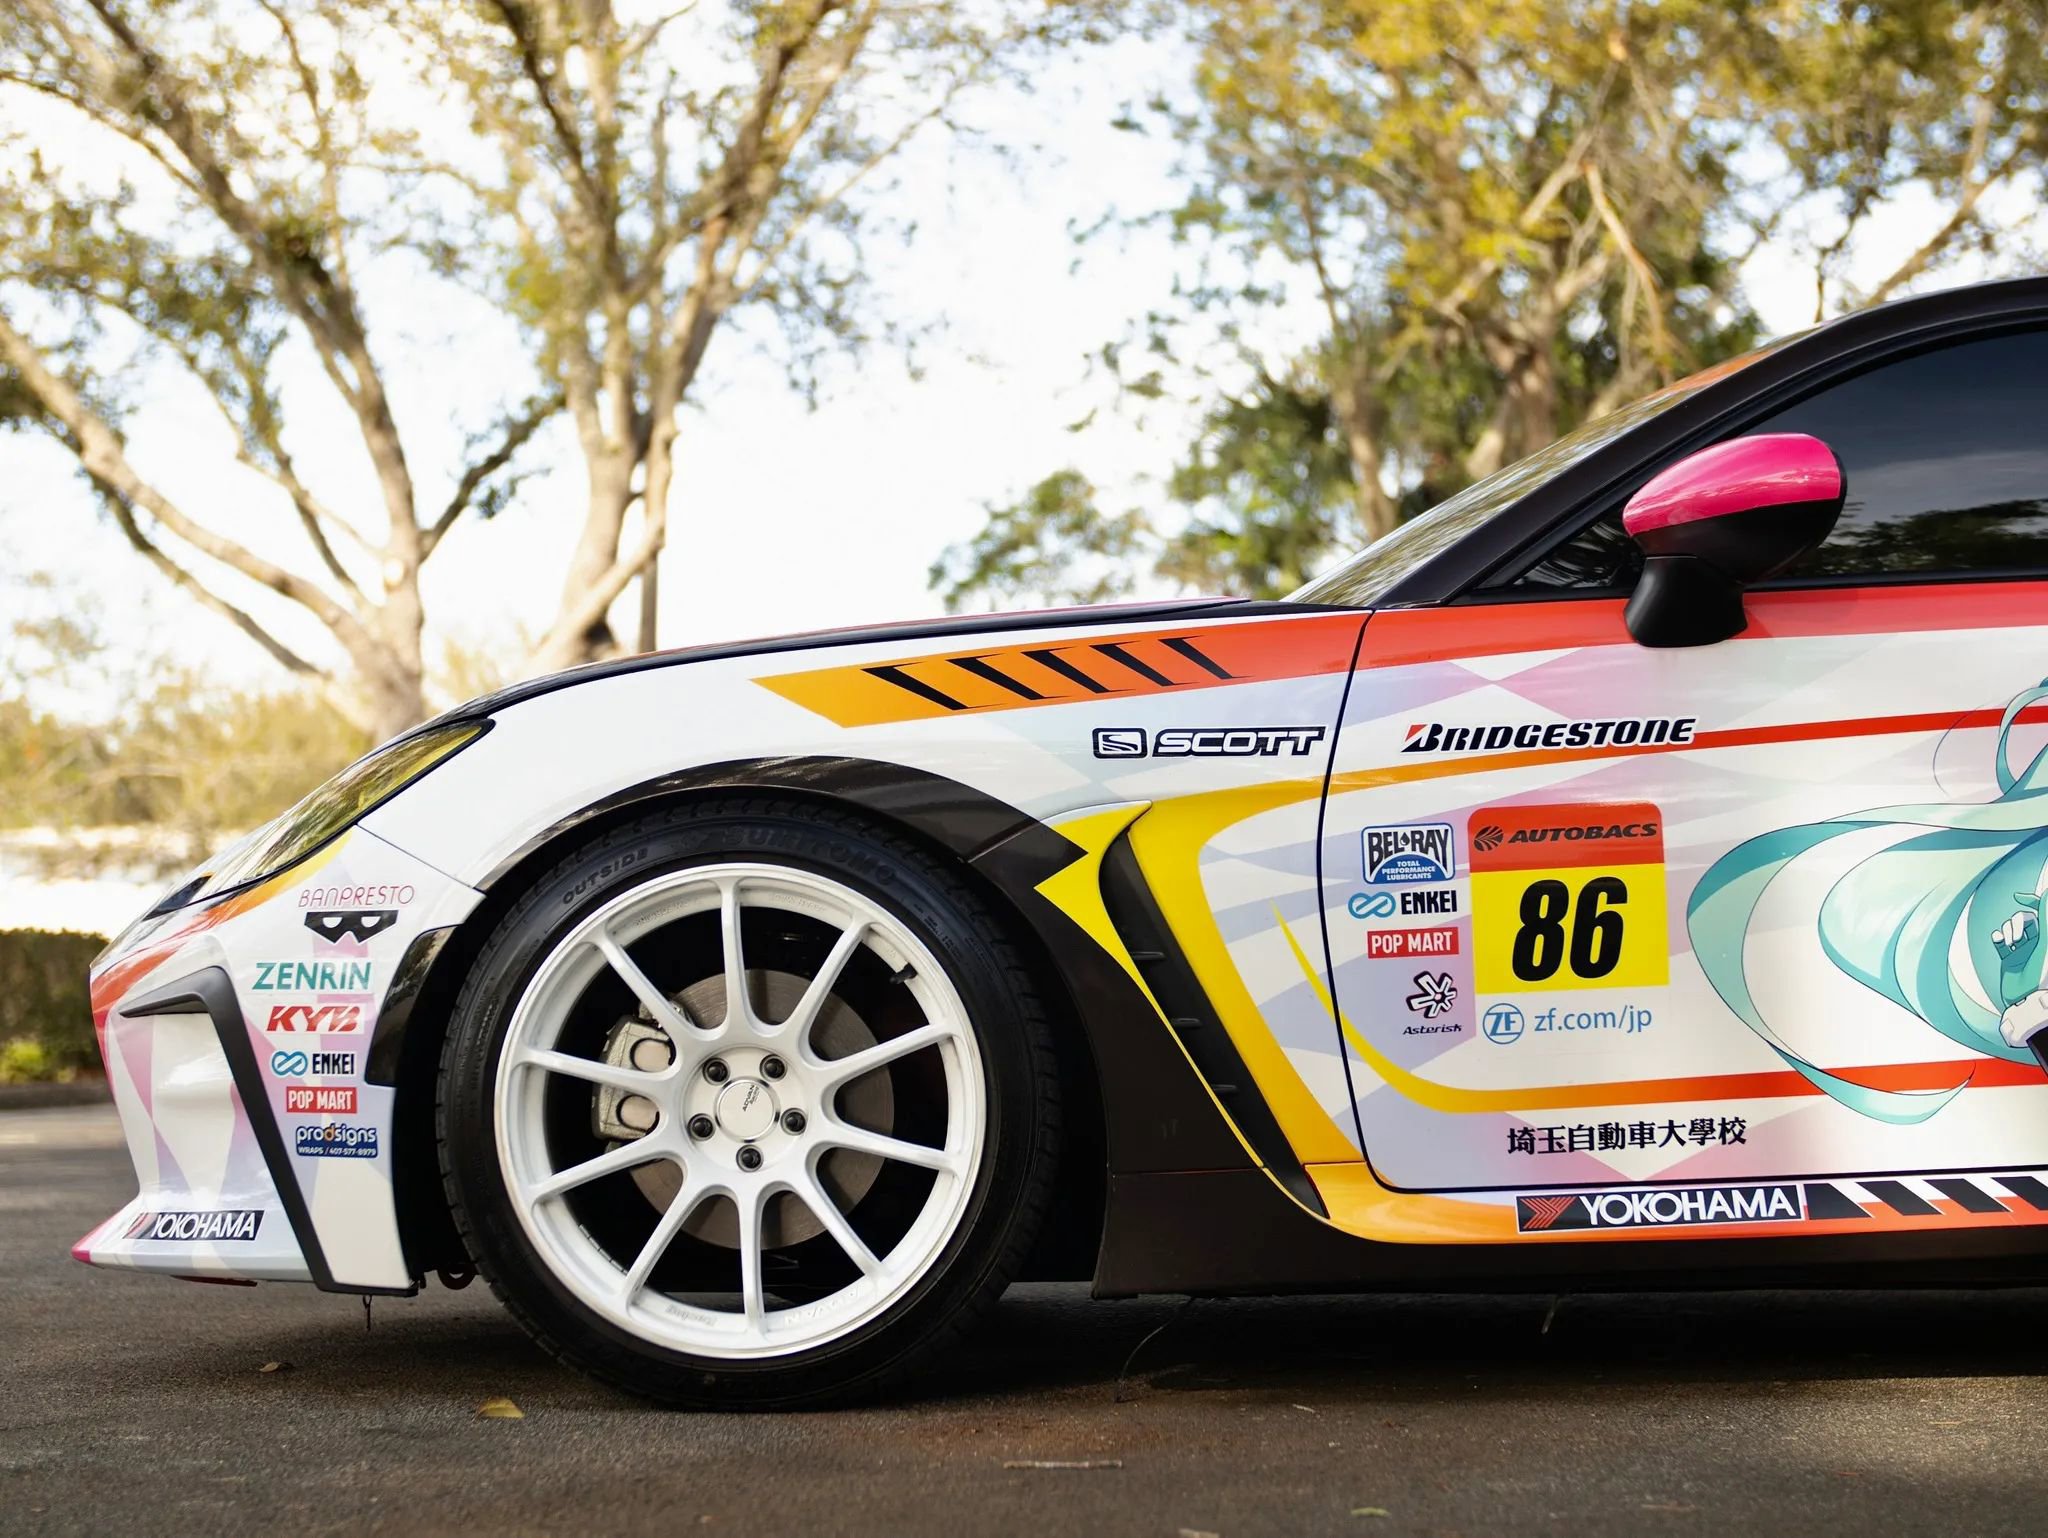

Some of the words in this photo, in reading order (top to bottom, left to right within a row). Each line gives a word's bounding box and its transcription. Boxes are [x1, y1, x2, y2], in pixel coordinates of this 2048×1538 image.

[1155, 728, 1323, 755] SCOTT
[1400, 718, 1697, 753] BRIDGESTONE
[1508, 823, 1658, 844] AUTOBACS
[562, 847, 650, 905] OUTSIDE
[1381, 865, 1436, 875] PERFORMANCE
[1386, 872, 1432, 881] LUBRICANTS
[298, 885, 415, 907] BANPRESTO
[1400, 890, 1458, 915] ENKEI
[1512, 876, 1628, 982] 86
[1371, 933, 1403, 955] POP
[1407, 931, 1453, 953] MART
[252, 962, 372, 990] ZENRIN
[266, 1005, 360, 1032] KYB
[1402, 1023, 1463, 1036] Asterisk
[1485, 1010, 1522, 1037] ZF
[1534, 1004, 1652, 1033] zf.com/jp
[312, 1053, 355, 1074] ENKEI
[287, 1090, 314, 1109] POP
[316, 1090, 353, 1110] MART
[297, 1123, 377, 1147] prodsigns
[1506, 1116, 1747, 1155] 埼玉自動車大學校
[297, 1146, 324, 1155] WRAPS
[1578, 1187, 1798, 1226] YOKOHAMA
[150, 1212, 256, 1239] YOKOHAMA
